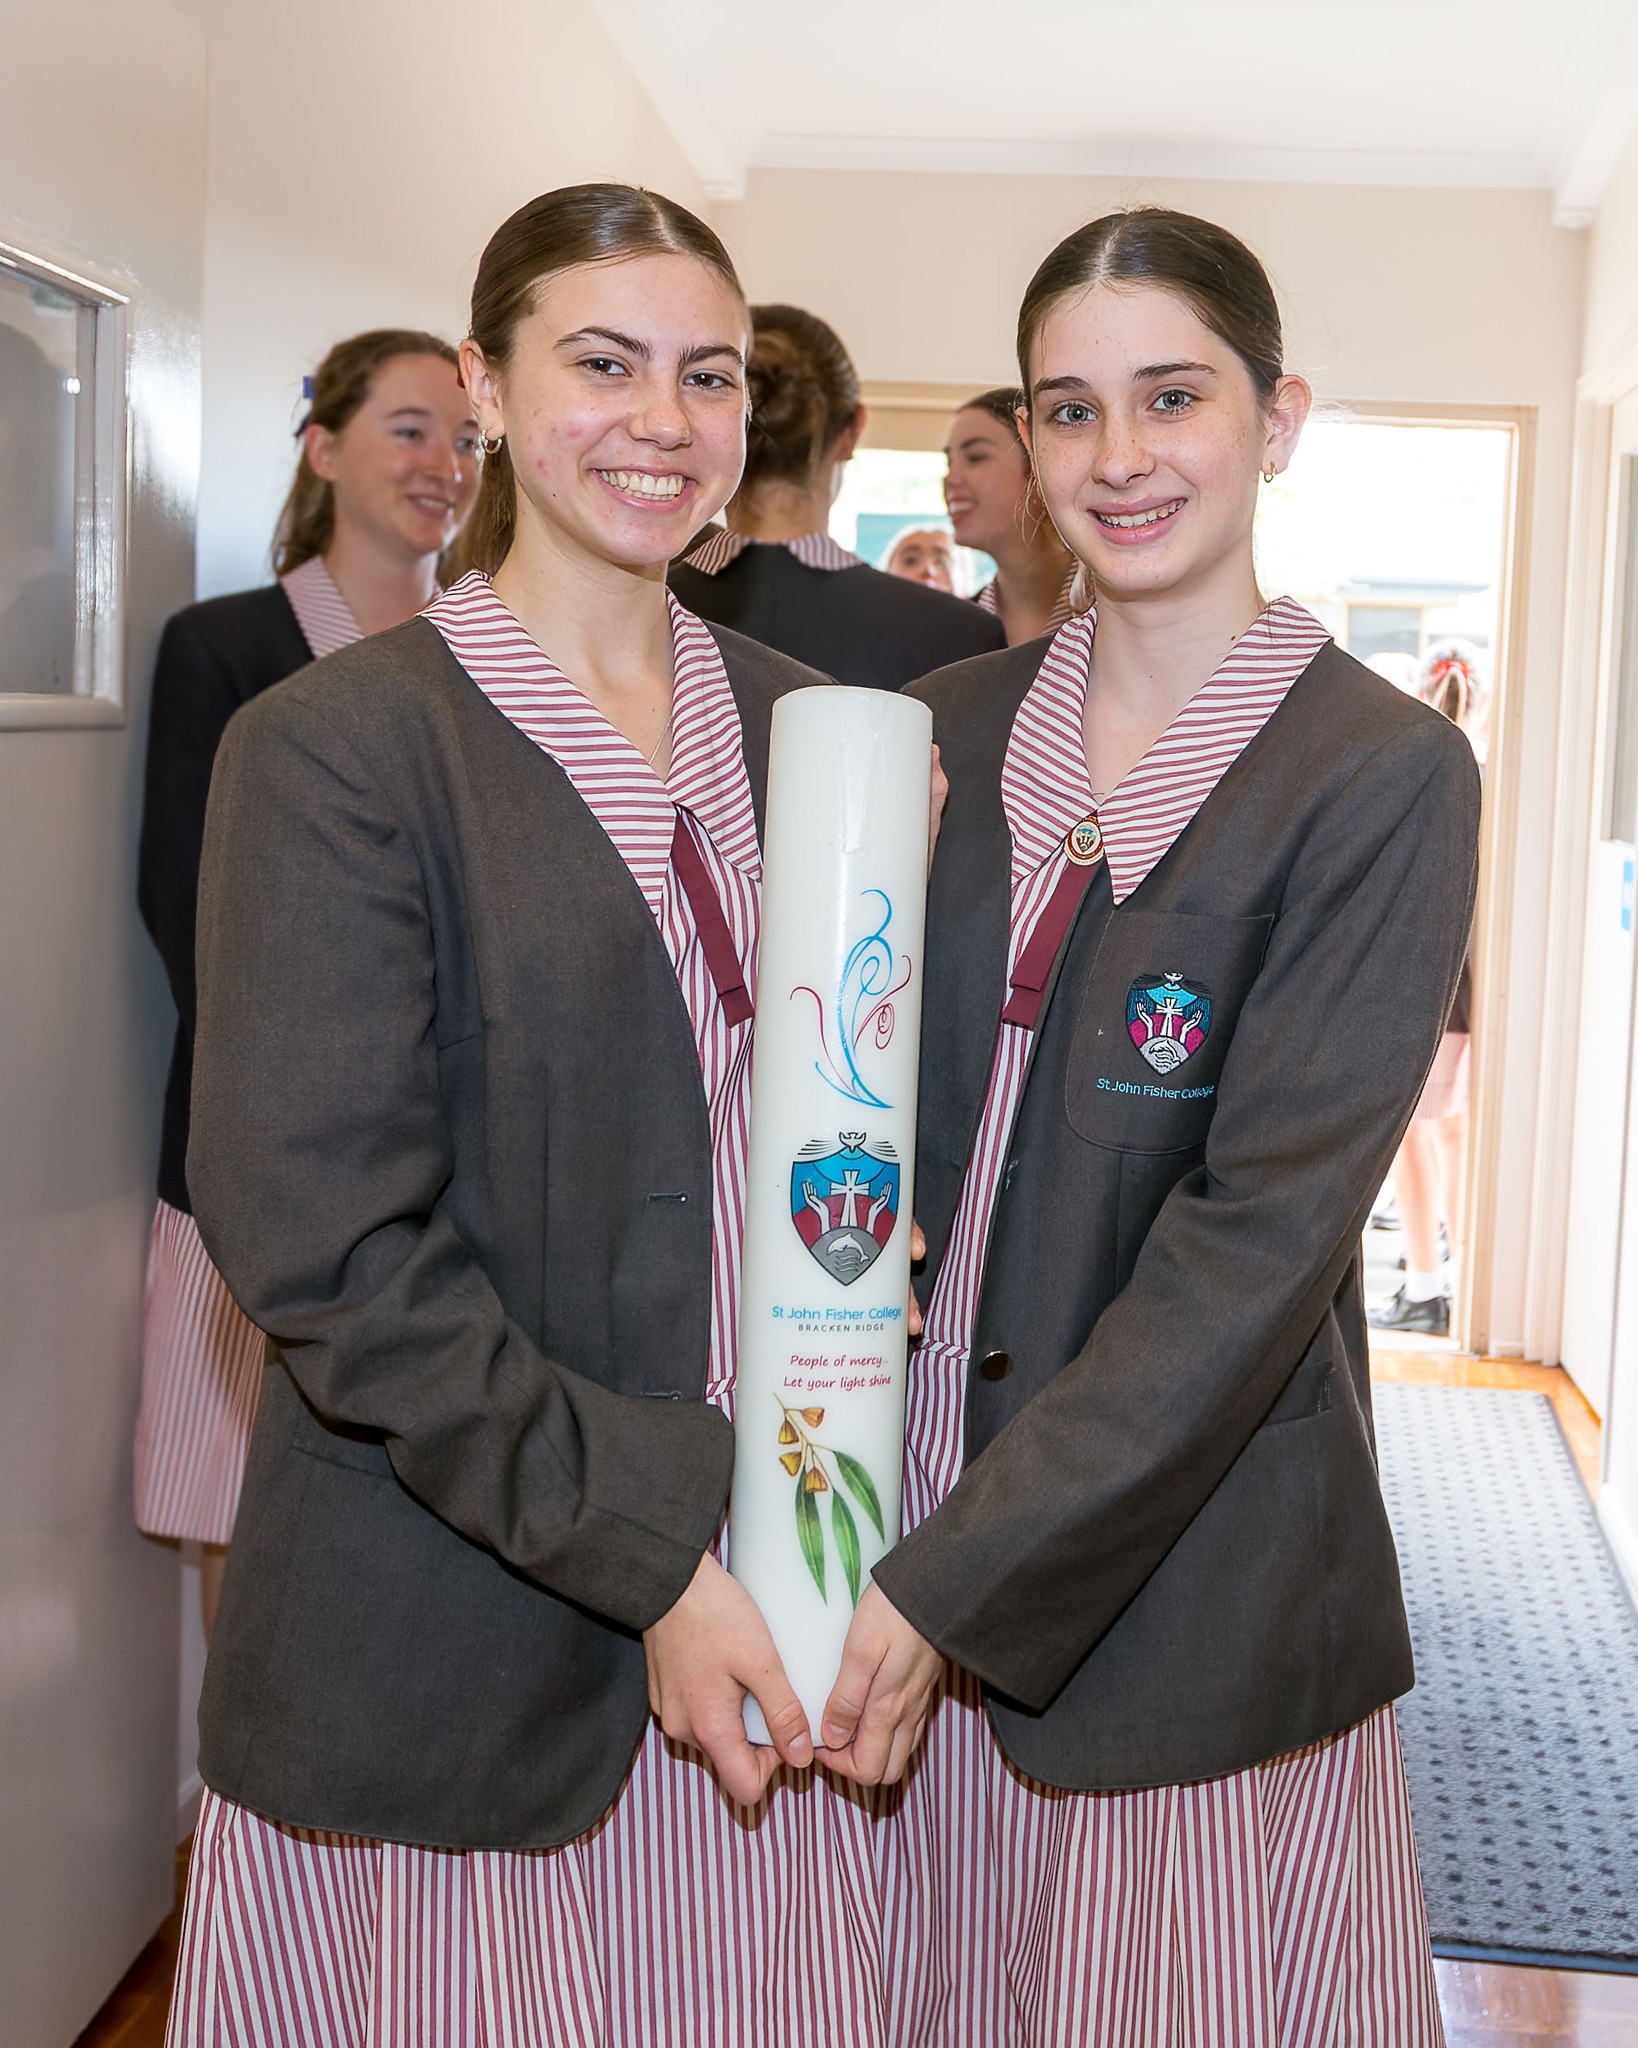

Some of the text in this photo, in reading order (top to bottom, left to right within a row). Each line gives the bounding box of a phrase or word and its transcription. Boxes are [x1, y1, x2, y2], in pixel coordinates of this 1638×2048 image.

[1096, 1078, 1111, 1091] St
[1111, 1081, 1141, 1095] John
[1143, 1085, 1181, 1099] Fisher
[772, 1306, 902, 1320] St John Fisher College
[798, 1322, 884, 1332] BRACKEN RIDGE
[790, 1355, 829, 1369] People
[833, 1354, 847, 1367] of
[784, 1374, 892, 1392] Let your light shine
